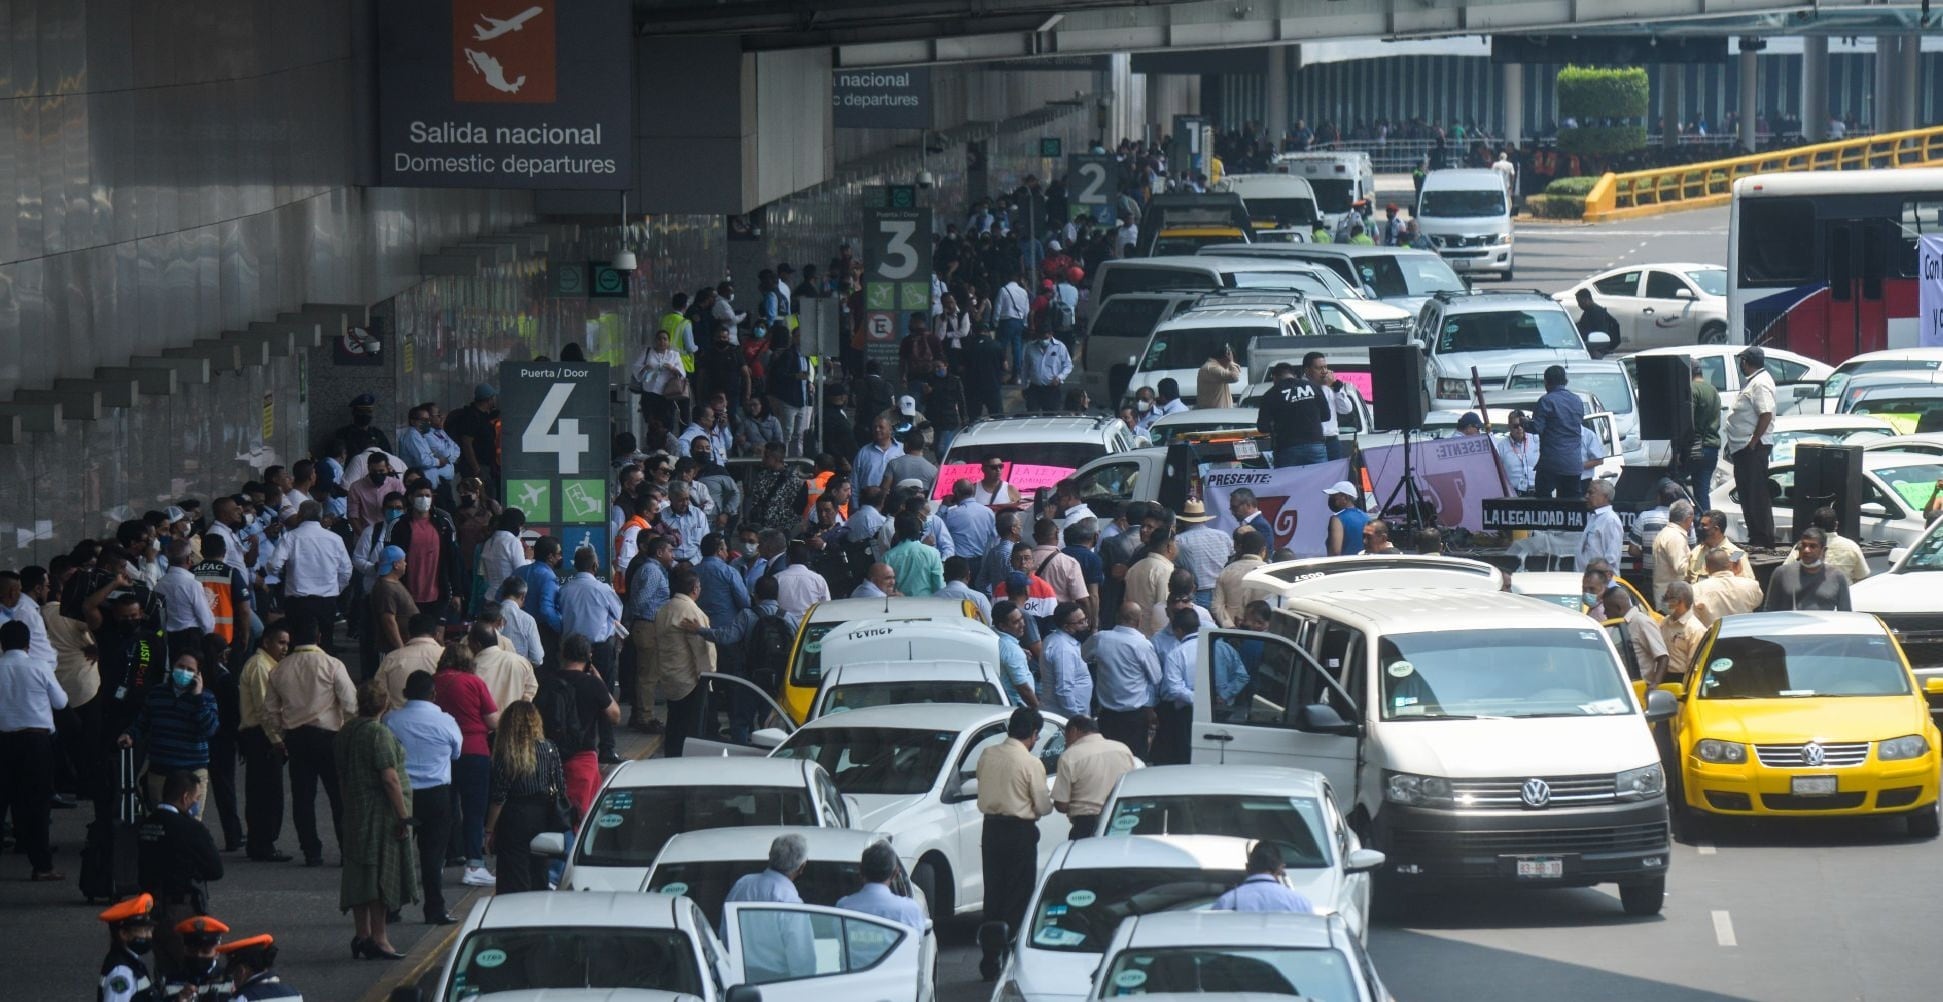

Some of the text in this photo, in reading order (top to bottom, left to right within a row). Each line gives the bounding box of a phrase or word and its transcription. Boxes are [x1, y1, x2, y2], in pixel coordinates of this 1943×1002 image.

[841, 72, 910, 87] nacional
[844, 93, 919, 109] departures
[409, 121, 601, 145] Salida nacional
[1186, 121, 1200, 154] 1
[395, 152, 616, 178] Domestic departures
[1078, 161, 1107, 204] 2
[877, 220, 919, 280] 3
[520, 368, 555, 379] Puerta
[563, 368, 589, 378] Door
[522, 382, 590, 475] 4
[1208, 473, 1272, 486] PRESENTE:
[1484, 509, 1499, 525] LA
[1501, 510, 1564, 526] LEGALIDAD
[1567, 511, 1583, 527] HA
